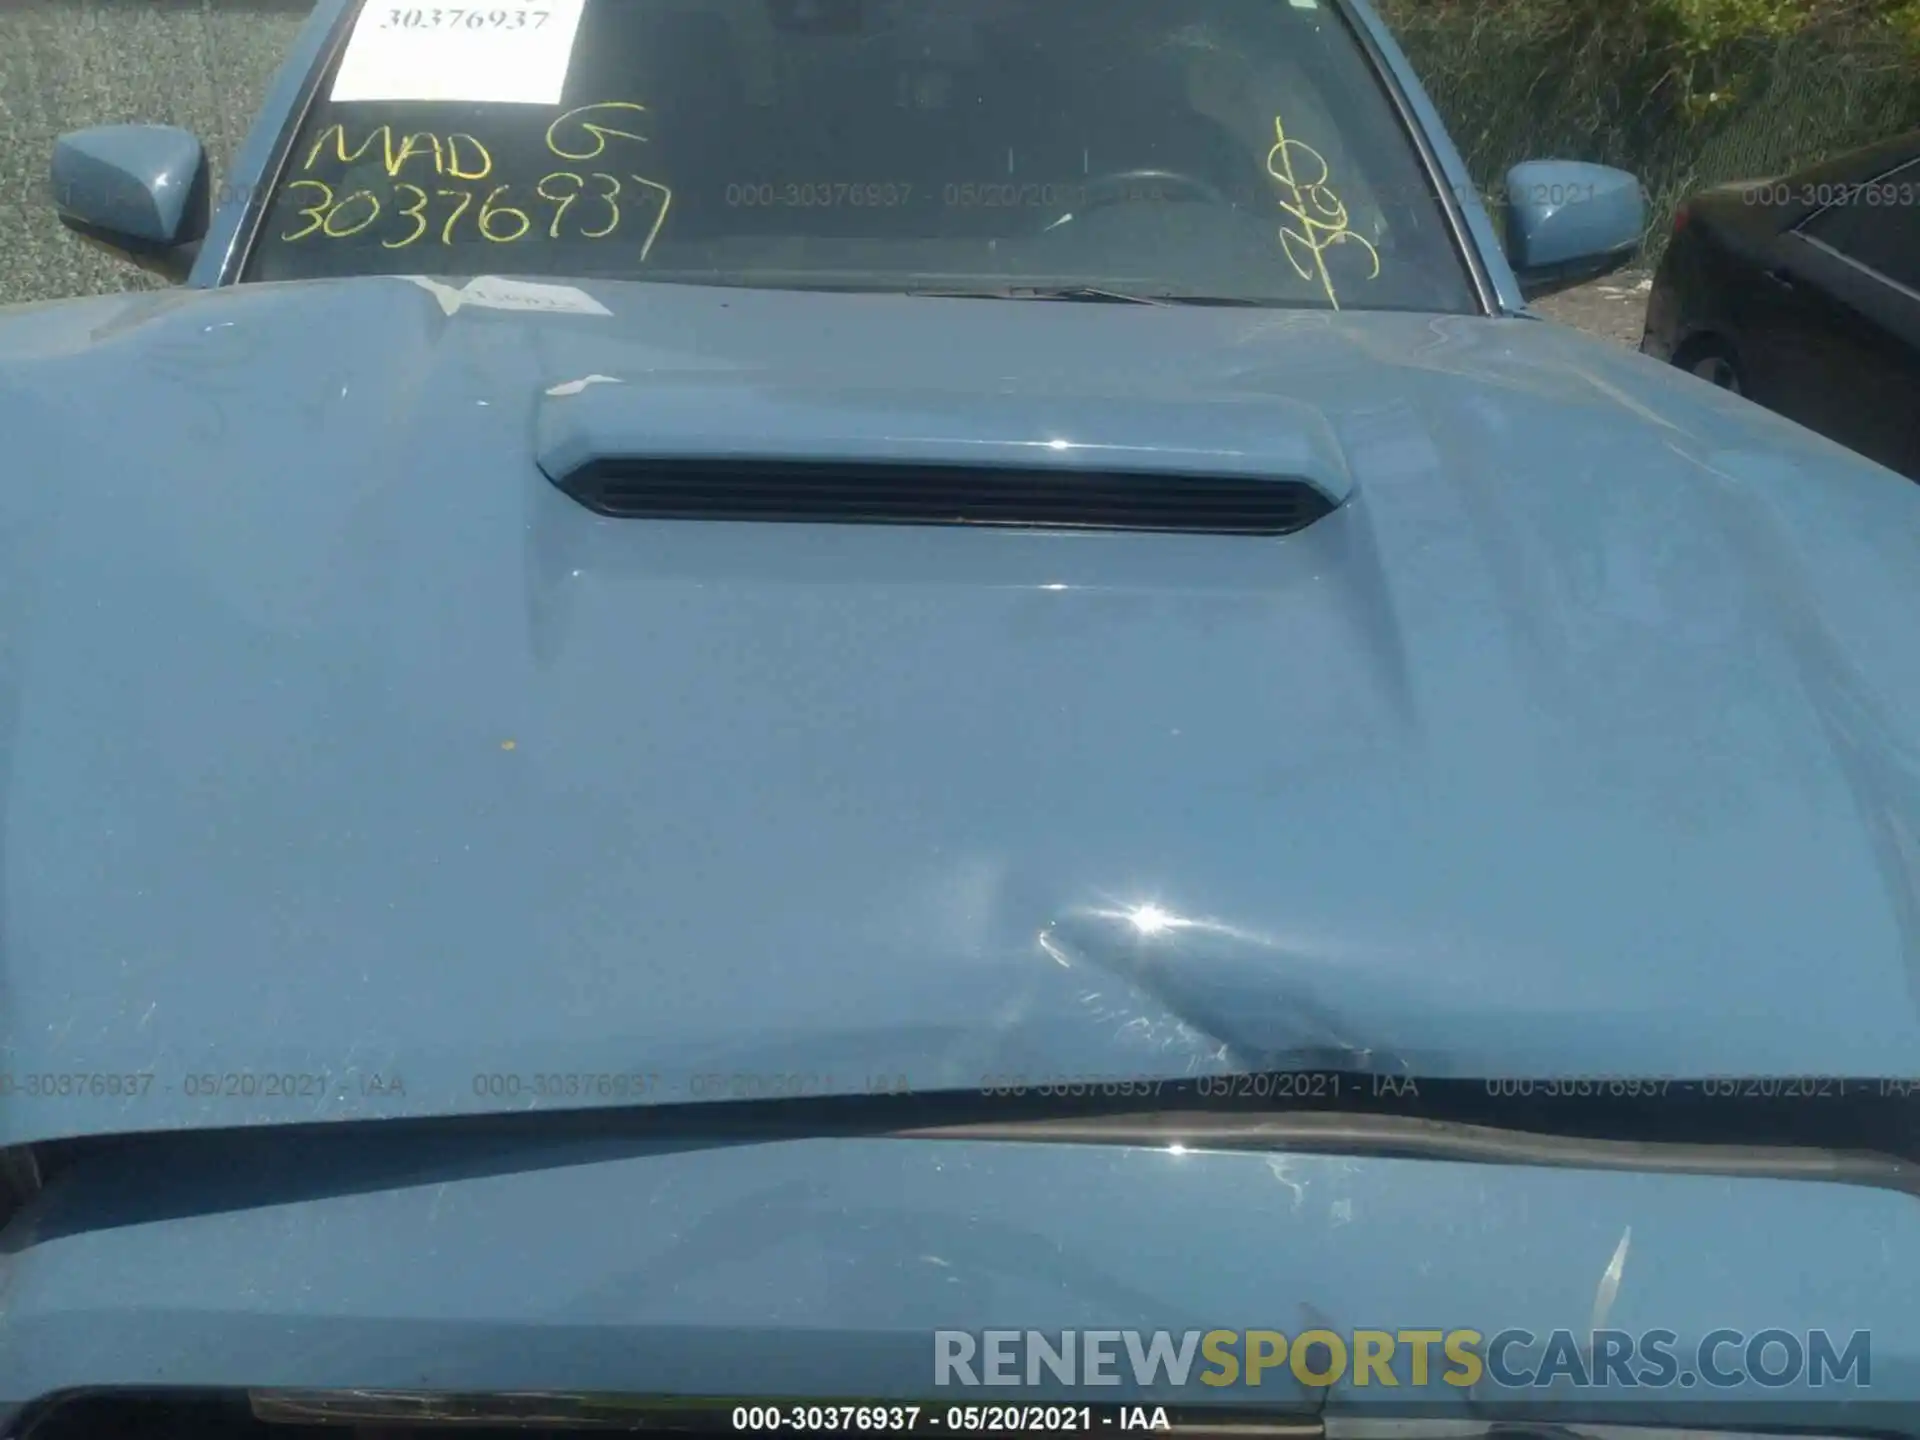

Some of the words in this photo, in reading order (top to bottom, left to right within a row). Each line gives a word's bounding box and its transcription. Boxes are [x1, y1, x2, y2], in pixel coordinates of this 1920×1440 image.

[379, 8, 550, 30] 30376937
[303, 123, 492, 180] MAD
[281, 172, 672, 262] 30376937
